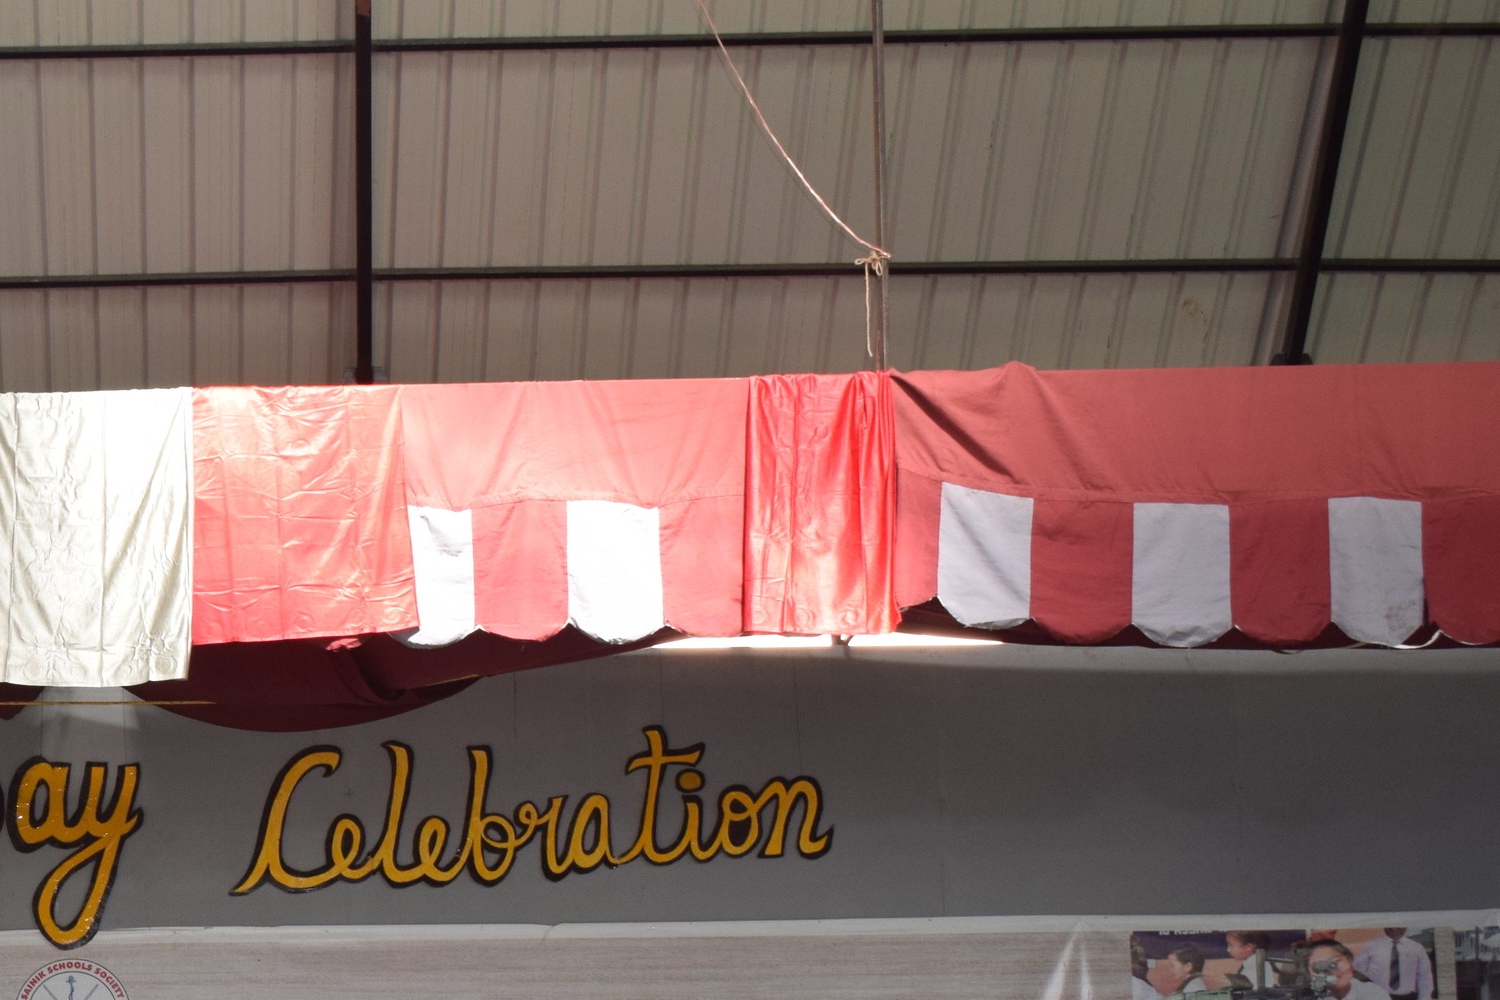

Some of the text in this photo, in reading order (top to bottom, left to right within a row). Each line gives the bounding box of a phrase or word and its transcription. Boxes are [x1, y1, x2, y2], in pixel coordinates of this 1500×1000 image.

[228, 725, 835, 897] Celebration
[20, 961, 125, 1000] SAINIK SCHOOLS SOCIETY
